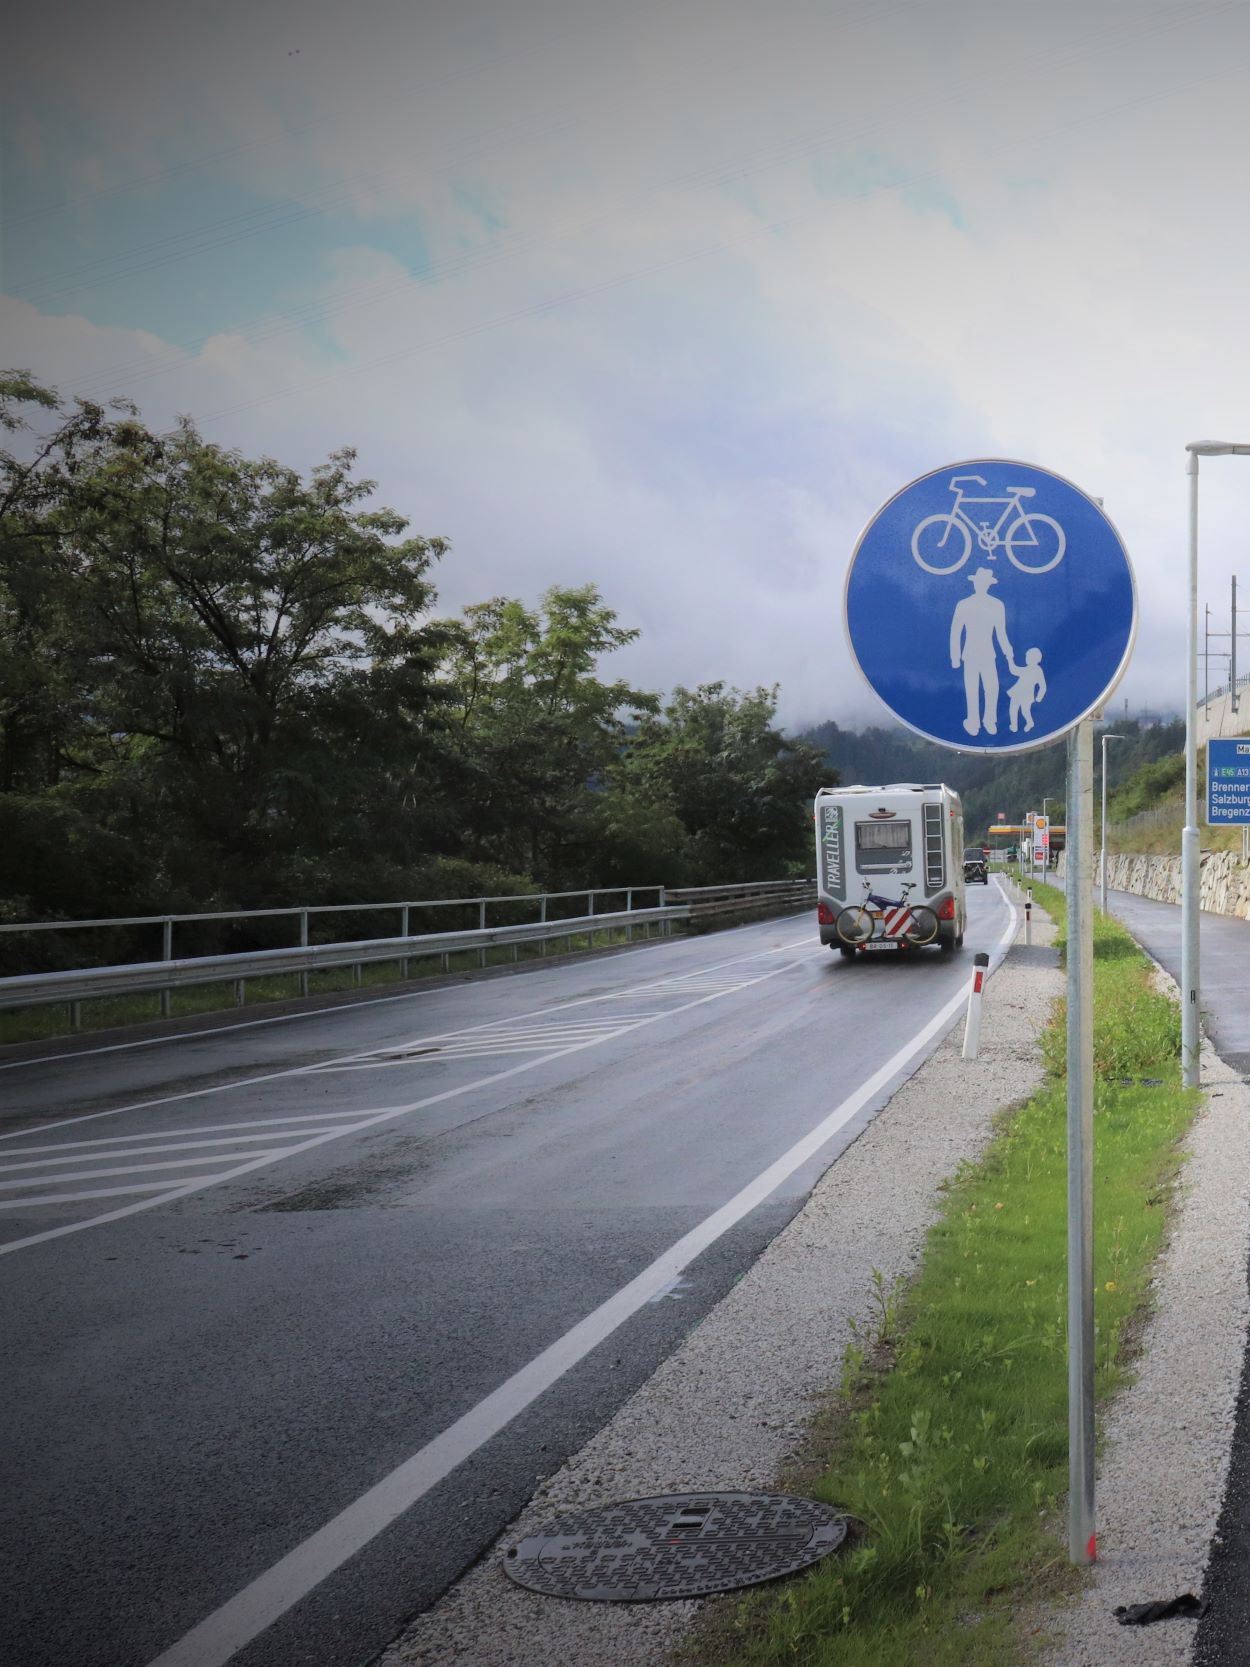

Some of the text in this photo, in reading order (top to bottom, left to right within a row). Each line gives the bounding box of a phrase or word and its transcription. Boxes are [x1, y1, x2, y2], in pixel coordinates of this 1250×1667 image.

[1237, 768, 1249, 776] A13
[1211, 782, 1250, 792] Brenner
[1212, 807, 1250, 818] Bregenz
[825, 824, 841, 889] TRAVELLER
